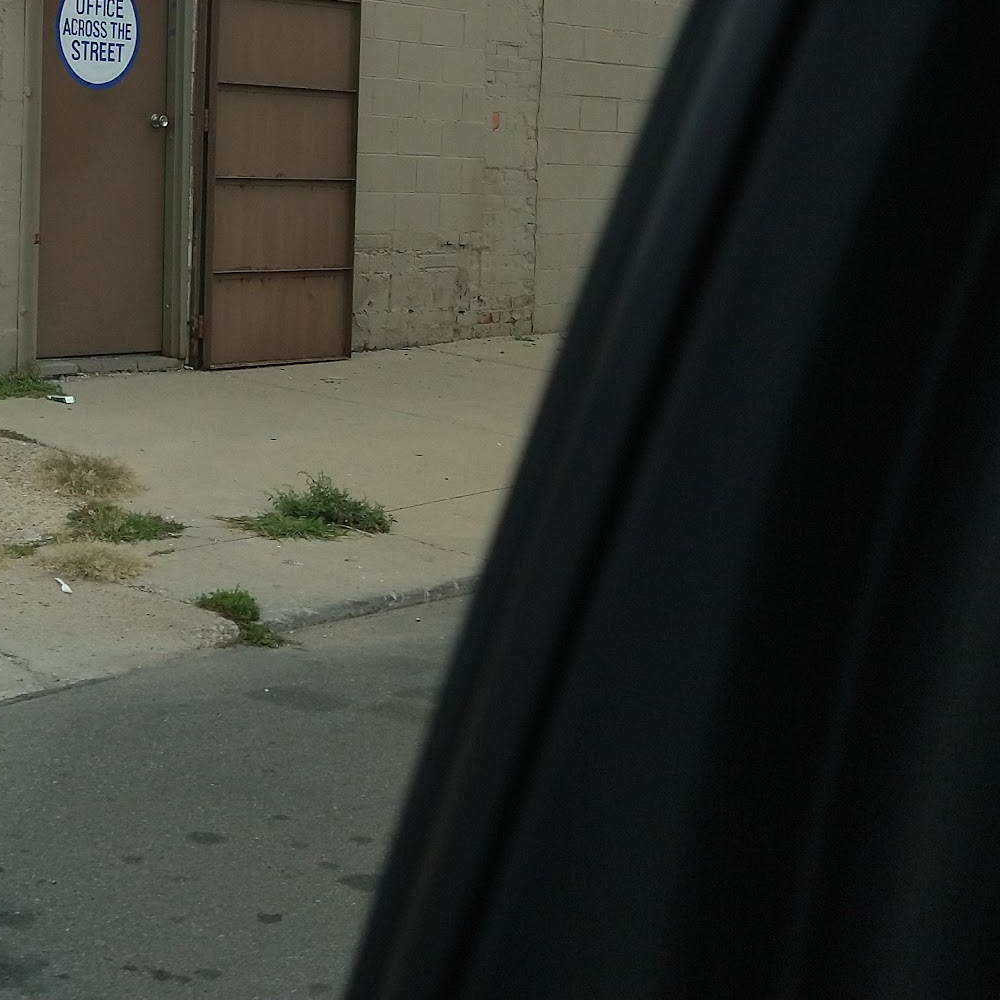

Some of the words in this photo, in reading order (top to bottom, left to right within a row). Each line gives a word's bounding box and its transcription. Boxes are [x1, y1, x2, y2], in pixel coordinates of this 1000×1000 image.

[62, 17, 107, 39] ACROSS
[110, 21, 132, 41] THE
[71, 39, 125, 63] STREET
